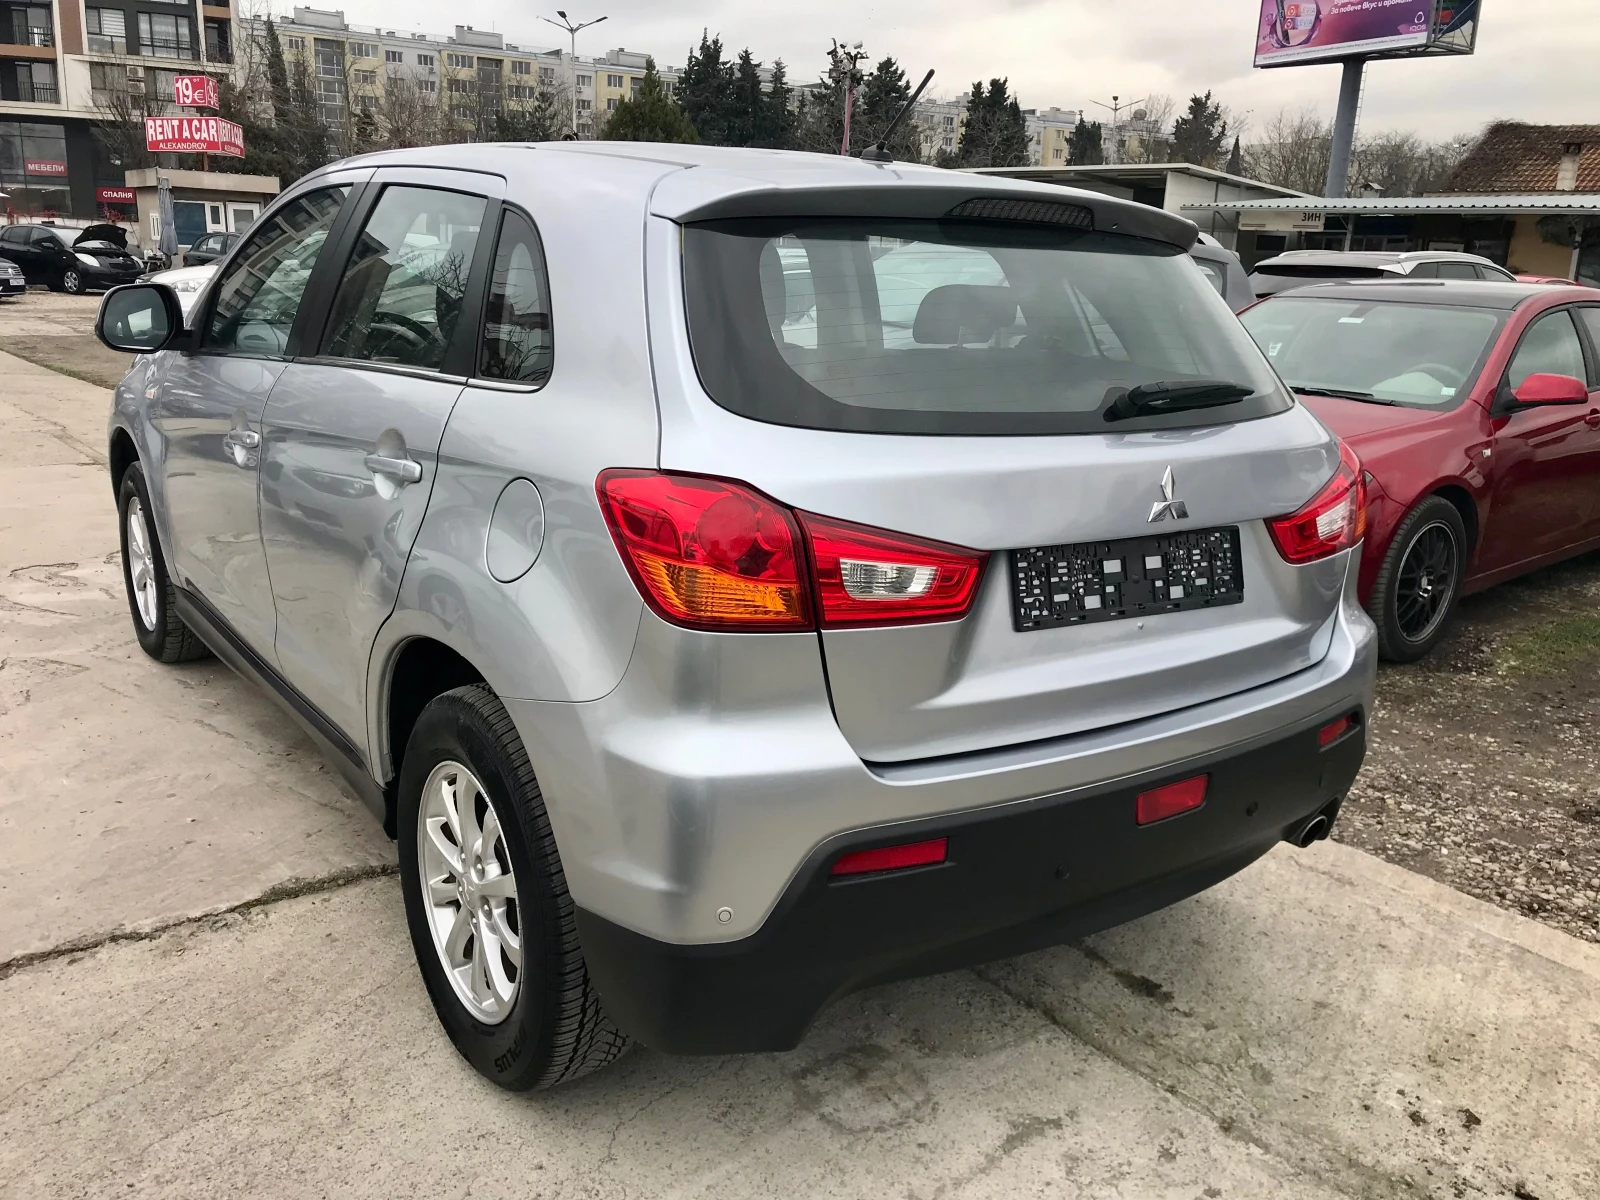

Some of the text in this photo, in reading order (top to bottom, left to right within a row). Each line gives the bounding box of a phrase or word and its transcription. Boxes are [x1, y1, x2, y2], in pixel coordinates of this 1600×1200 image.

[1340, 4, 1361, 14] повече
[1362, 1, 1377, 11] вкус
[147, 119, 218, 142] RENT A CAR
[159, 142, 207, 150] ALEXANDROV
[28, 163, 65, 173] МЕБЕЛИ
[102, 190, 133, 199] СПАЛНЯ
[1301, 212, 1322, 222] ЗИН
